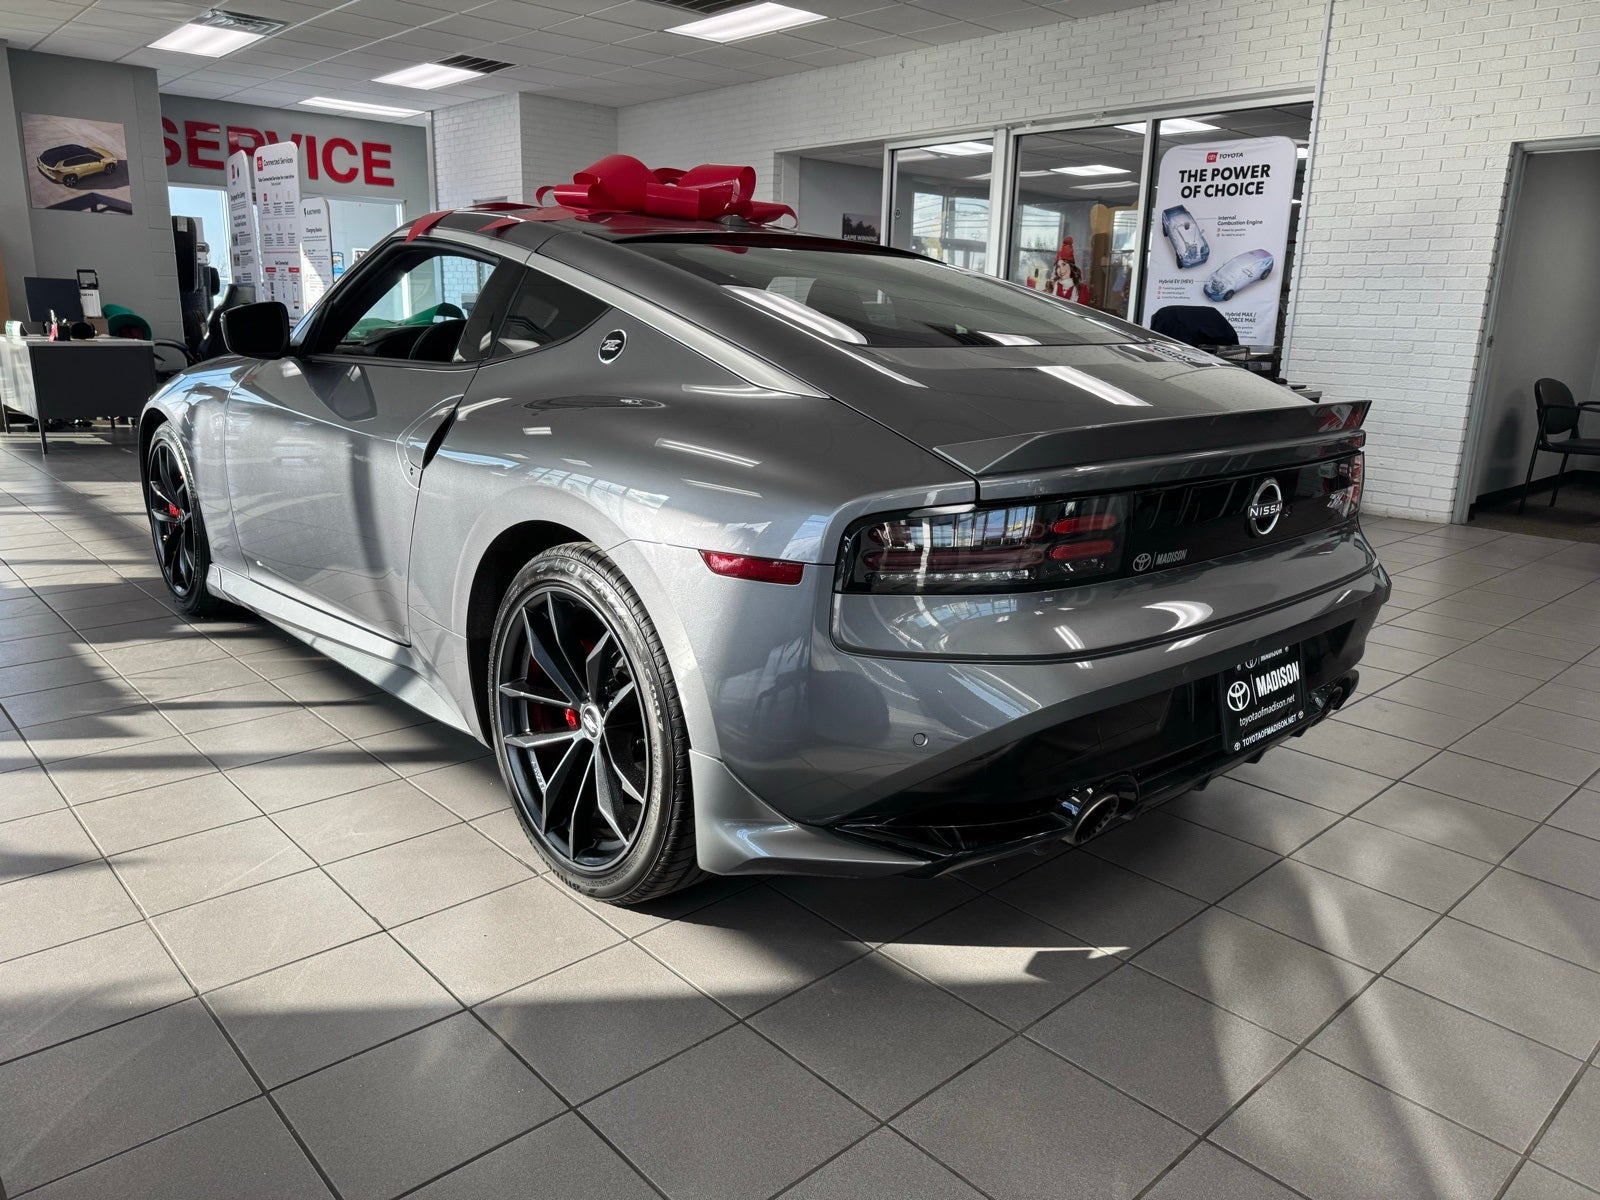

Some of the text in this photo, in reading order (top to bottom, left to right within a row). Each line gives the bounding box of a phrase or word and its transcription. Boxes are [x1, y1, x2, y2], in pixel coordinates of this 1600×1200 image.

[1179, 164, 1271, 183] THE POWER
[1181, 181, 1265, 199] OF CHOICE
[1156, 549, 1188, 566] MADISON
[1255, 661, 1300, 698] MADISON
[1239, 693, 1296, 727] toyotaofmadison.net
[1242, 714, 1297, 747] TOYOTAOFMADISON.NET
